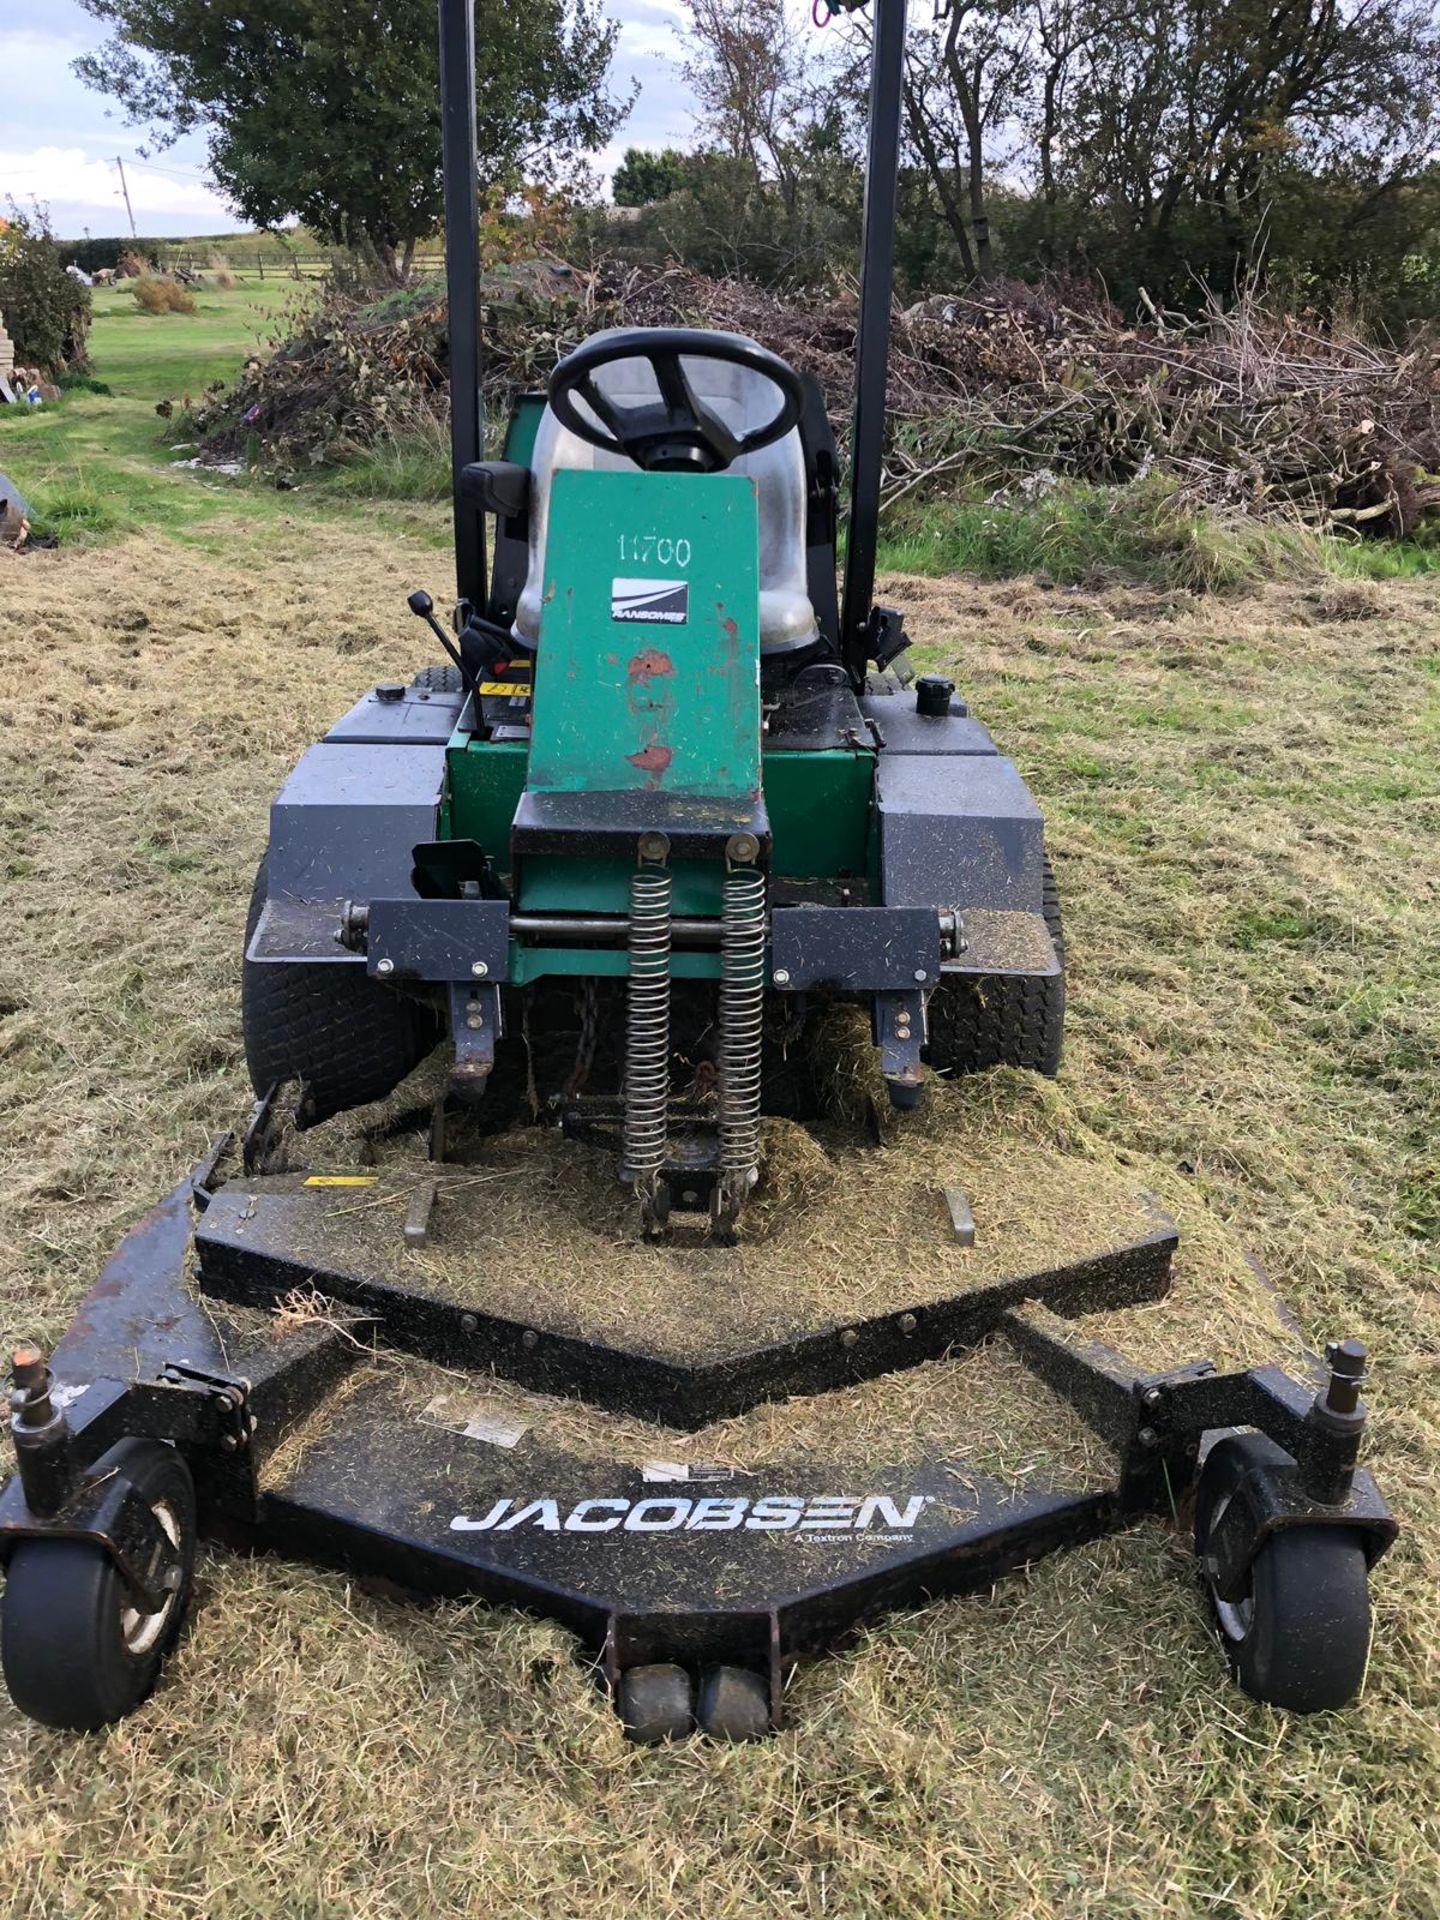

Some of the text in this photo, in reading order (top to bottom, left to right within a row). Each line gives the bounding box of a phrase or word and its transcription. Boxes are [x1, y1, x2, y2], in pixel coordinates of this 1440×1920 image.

[612, 610, 686, 622] RANSOMES
[450, 1495, 924, 1532] JACOBSEN
[794, 1533, 913, 1543] A Textron Company
